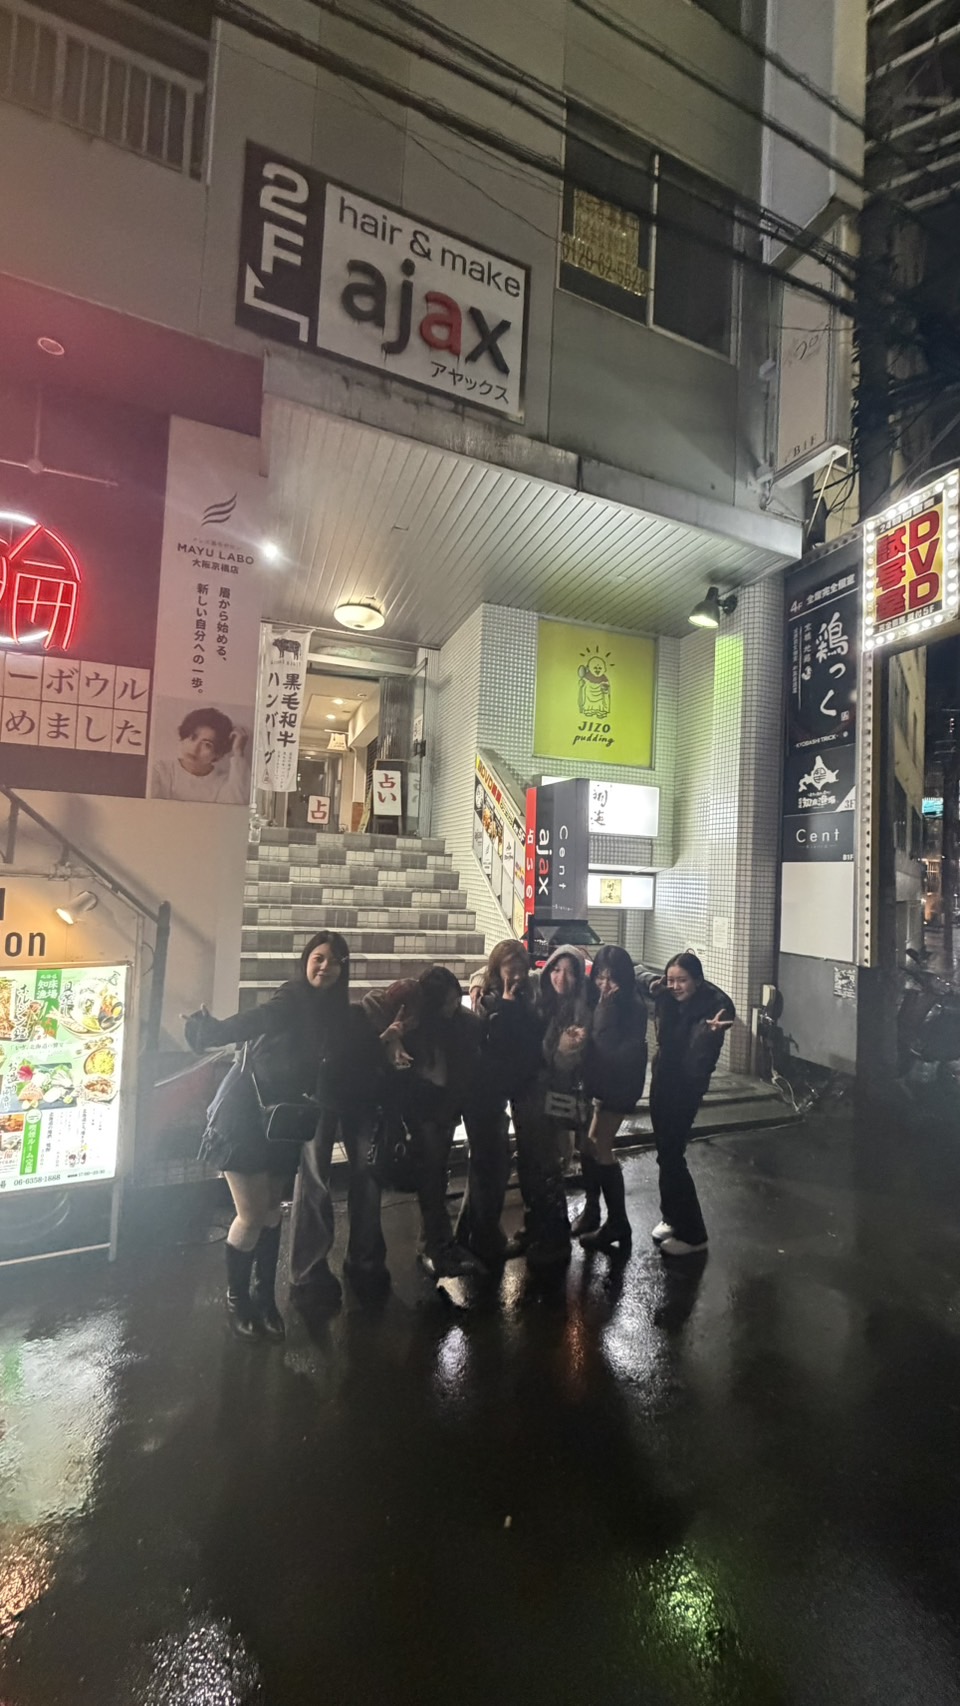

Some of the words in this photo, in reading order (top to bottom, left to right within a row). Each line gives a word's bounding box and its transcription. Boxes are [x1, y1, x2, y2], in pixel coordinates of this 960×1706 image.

[260, 162, 309, 274] 2F
[339, 196, 403, 246] hair
[409, 230, 433, 262] &
[441, 247, 521, 298] make
[341, 258, 511, 376] ajax
[430, 360, 510, 405] アヤックス
[177, 542, 214, 558] MAYU
[218, 551, 254, 565] LABO
[192, 558, 240, 575] 大阪京橋店
[909, 510, 940, 610] DVD
[191, 582, 210, 695] 新しい自分への一歩。
[215, 586, 231, 662] 眉から始める、
[8, 667, 148, 702] ーボウル
[5, 709, 143, 747] めました
[263, 671, 280, 765] ハンバーグ
[277, 672, 302, 748] 黒毛和牛
[577, 721, 611, 734] JIZO
[571, 733, 615, 748] pudding
[310, 799, 329, 821] 占
[376, 773, 398, 804] 占い
[558, 825, 569, 890] Cent
[796, 828, 840, 843] Cent
[536, 828, 552, 896] ajax
[5, 931, 46, 957] on
